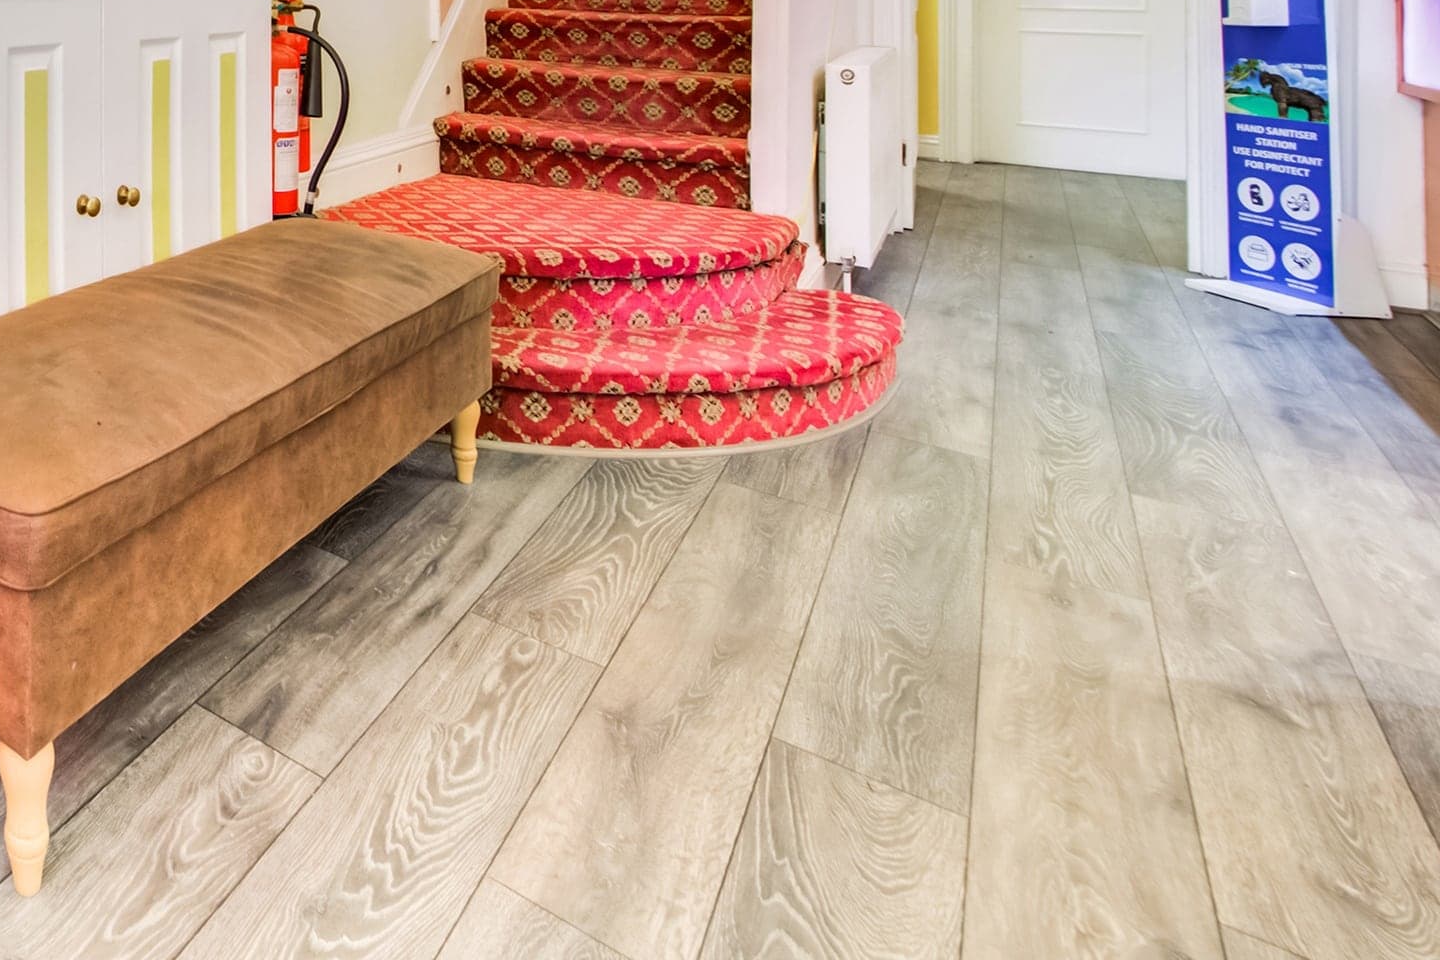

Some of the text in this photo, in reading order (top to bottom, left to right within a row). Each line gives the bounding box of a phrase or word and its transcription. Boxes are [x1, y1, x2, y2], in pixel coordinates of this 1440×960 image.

[1236, 123, 1318, 141] HAND SANITISER
[1233, 146, 1252, 156] USE
[1245, 160, 1311, 177] FOR PROTECT
